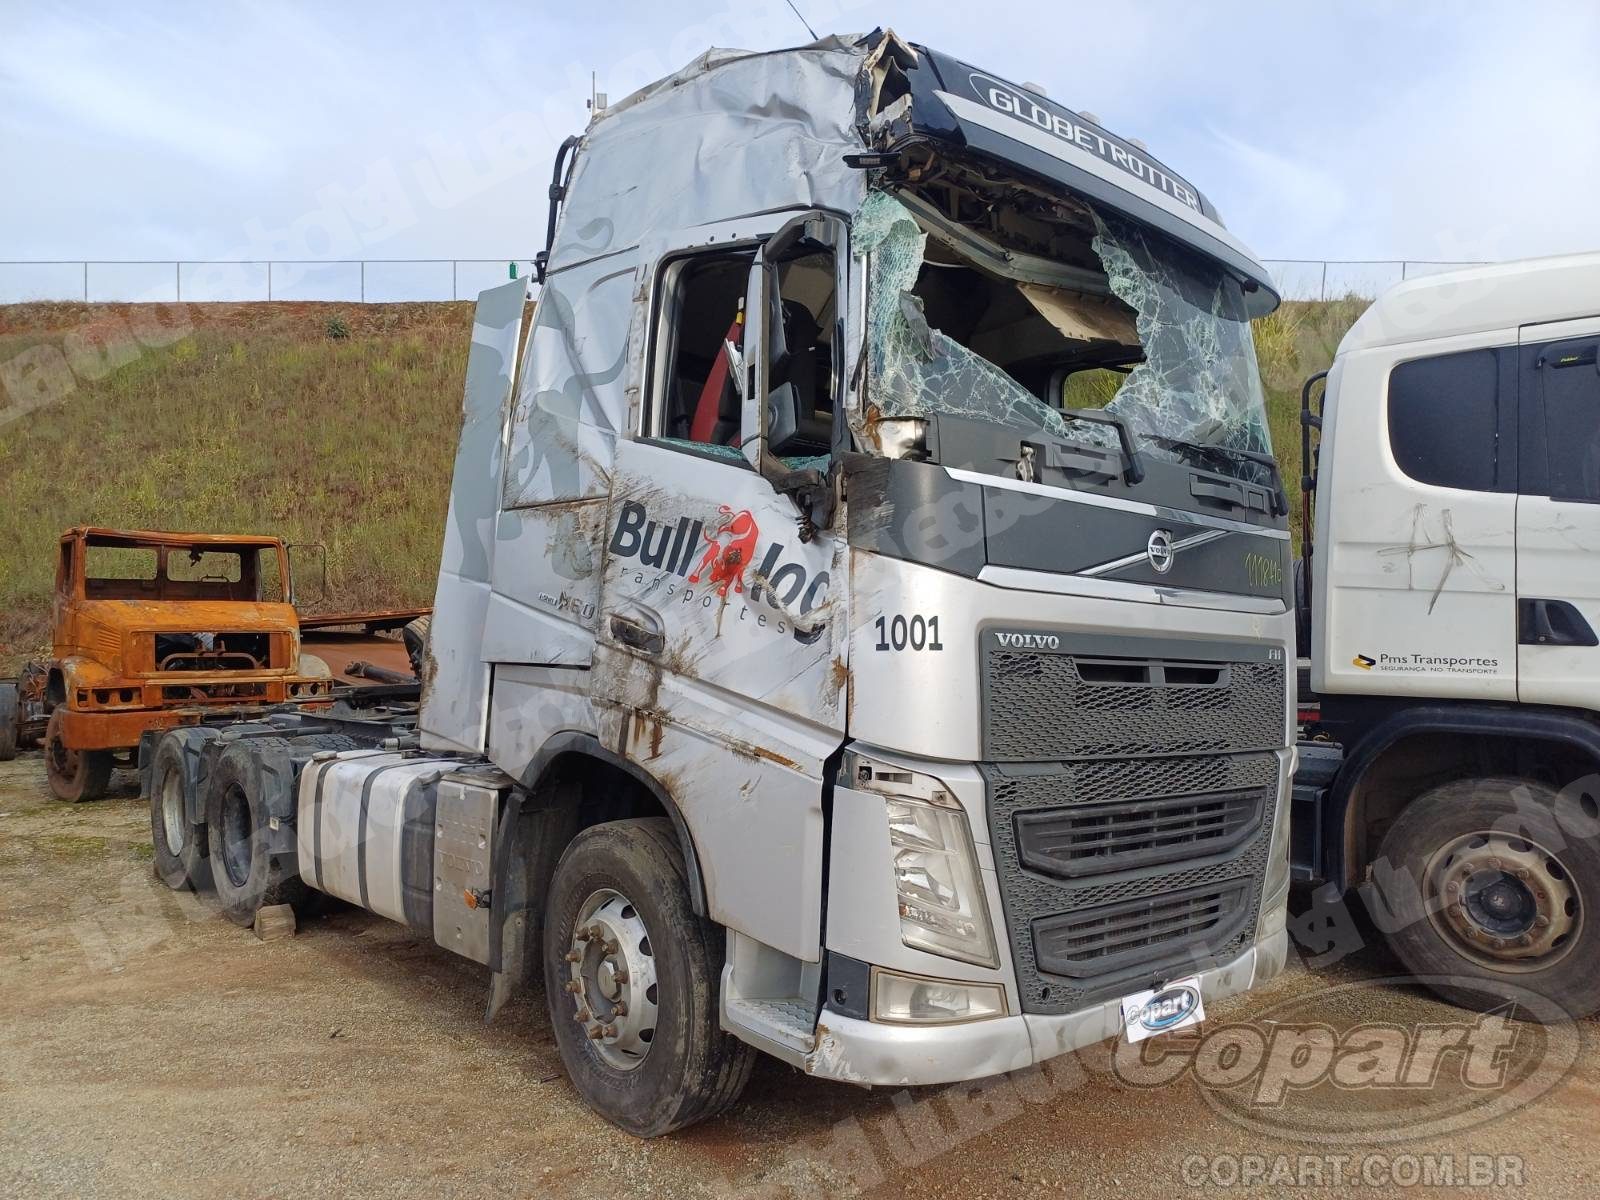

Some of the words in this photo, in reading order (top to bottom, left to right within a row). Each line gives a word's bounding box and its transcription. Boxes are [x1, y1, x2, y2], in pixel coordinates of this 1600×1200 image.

[989, 88, 1198, 209] GLOBETROTTER
[609, 499, 704, 578] Bull
[875, 614, 944, 652] 1001
[995, 631, 1060, 650] VOLVO
[1380, 653, 1408, 664] Pms
[1410, 654, 1498, 667] Transportes
[1446, 667, 1498, 675] TRANSPORTE
[1126, 990, 1191, 1027] Copart
